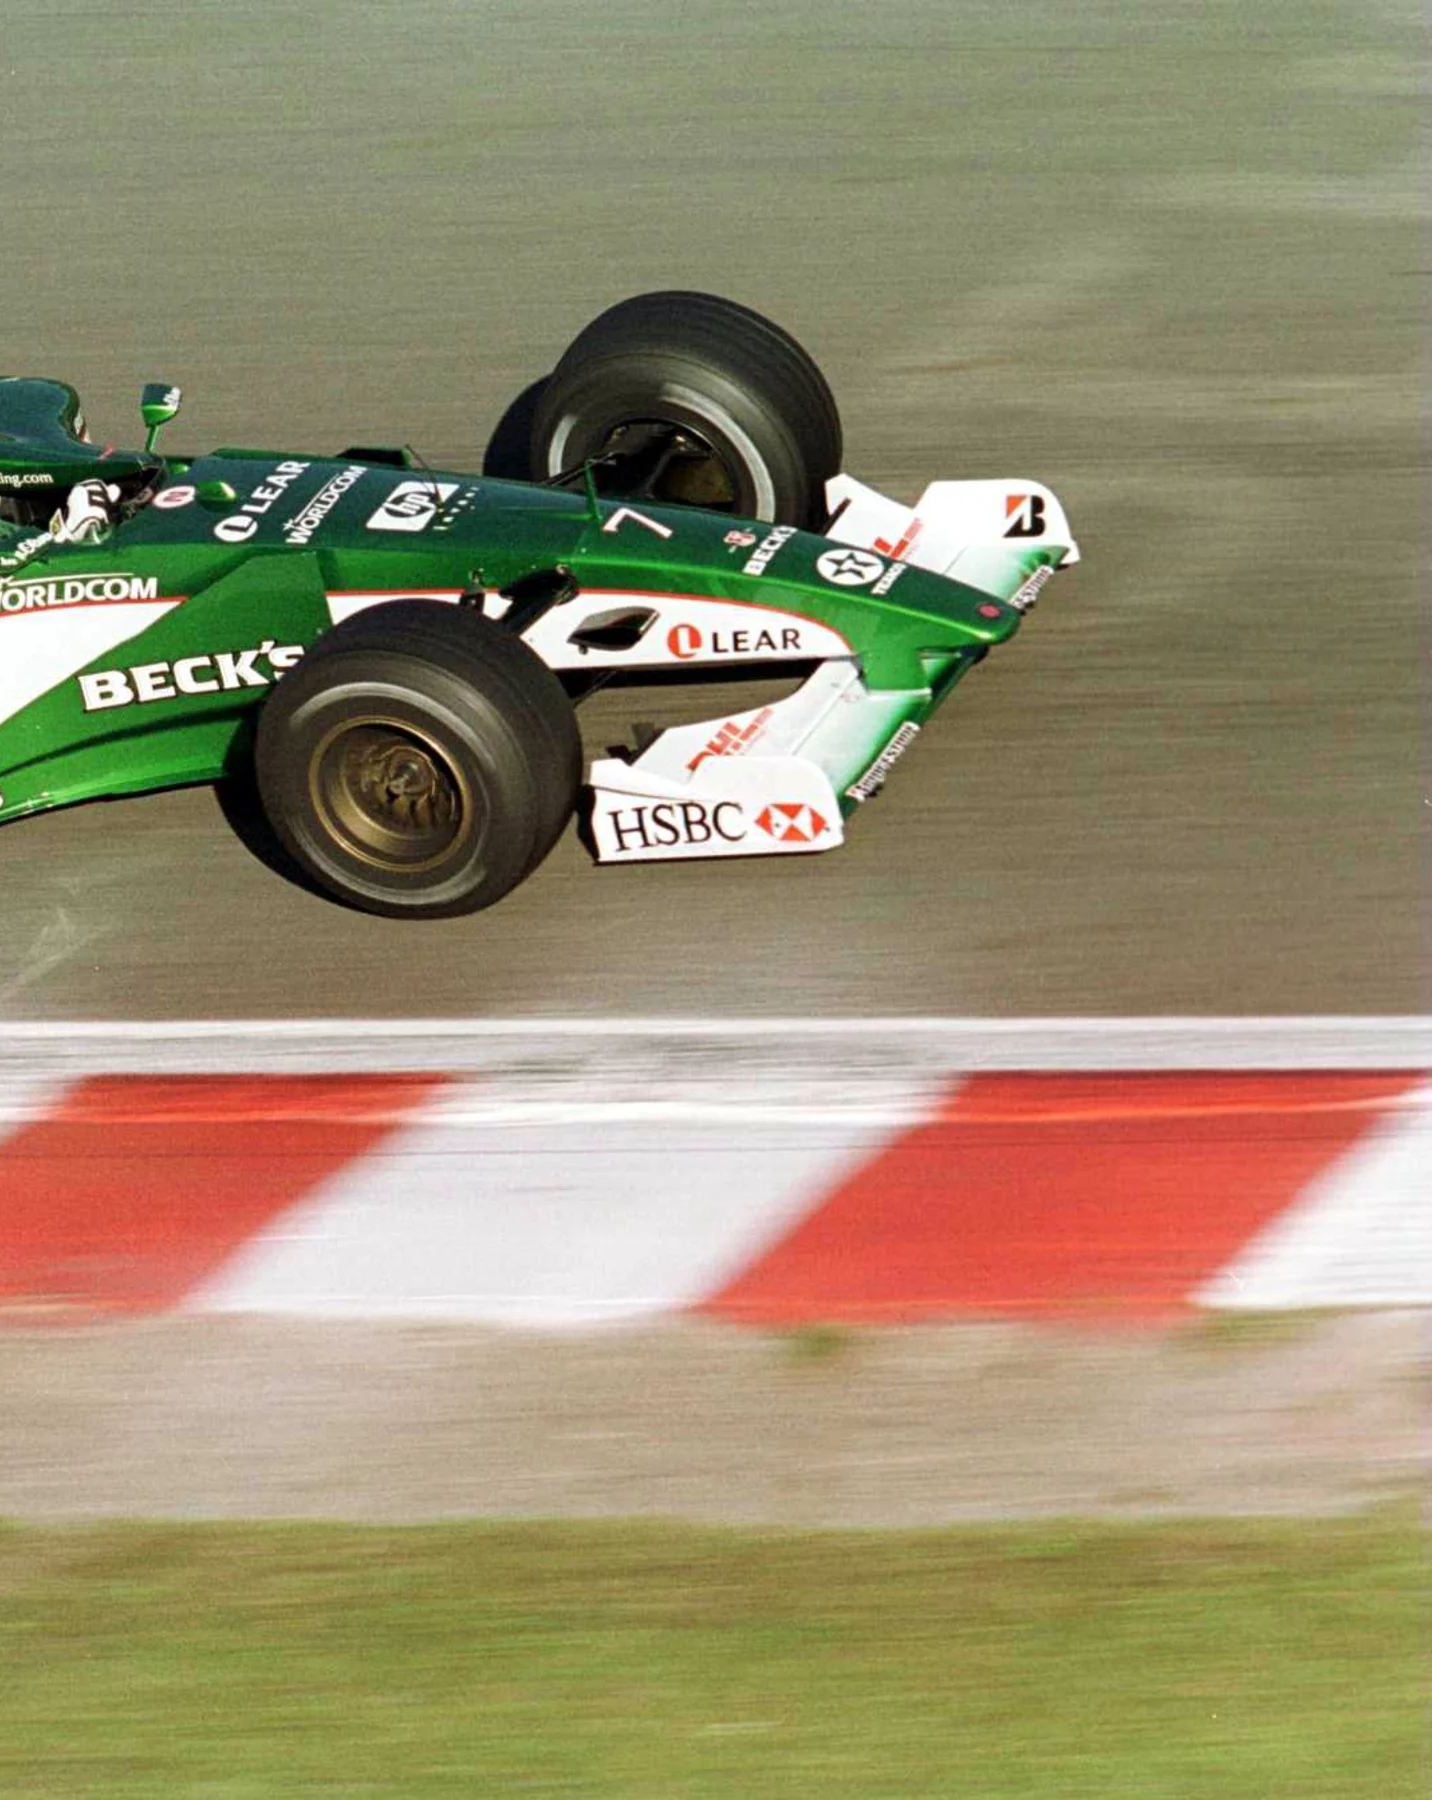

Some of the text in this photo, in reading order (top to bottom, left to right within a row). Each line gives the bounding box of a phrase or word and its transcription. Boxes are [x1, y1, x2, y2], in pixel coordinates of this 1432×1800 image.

[241, 461, 311, 514] LEAR
[285, 465, 368, 544] WORLDCOM
[602, 508, 673, 539] 7
[711, 627, 801, 654] LEAR
[78, 641, 305, 712] BECK'S
[608, 802, 749, 851] HSBC
